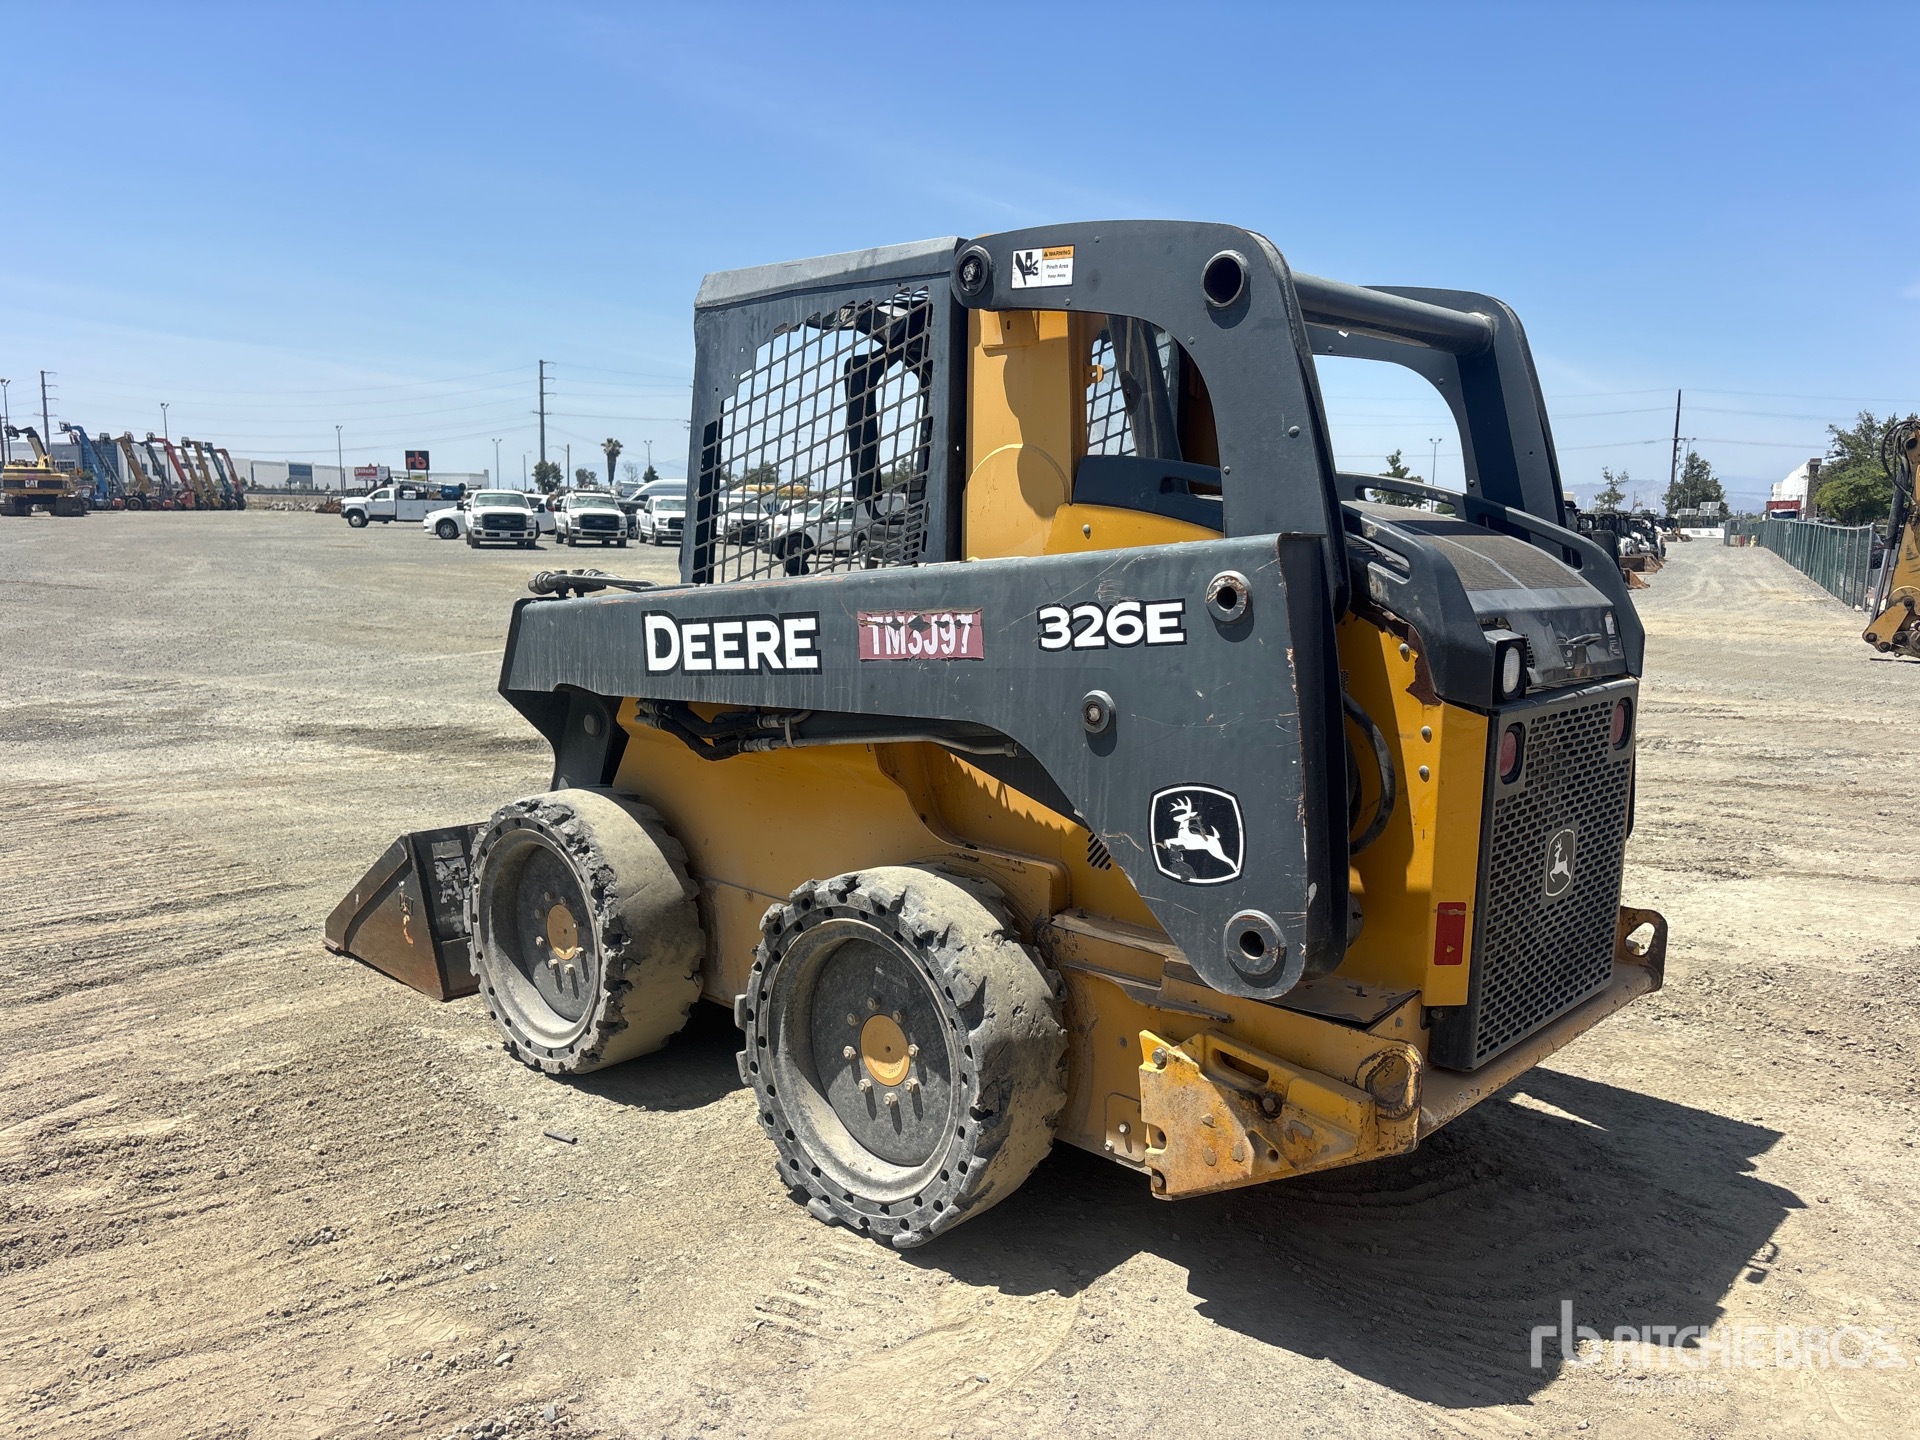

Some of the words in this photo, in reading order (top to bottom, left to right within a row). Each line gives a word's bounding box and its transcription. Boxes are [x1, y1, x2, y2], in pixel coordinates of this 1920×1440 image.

[25, 480, 38, 488] CAT
[644, 614, 820, 672] DEERE
[1039, 600, 1186, 649] 326E
